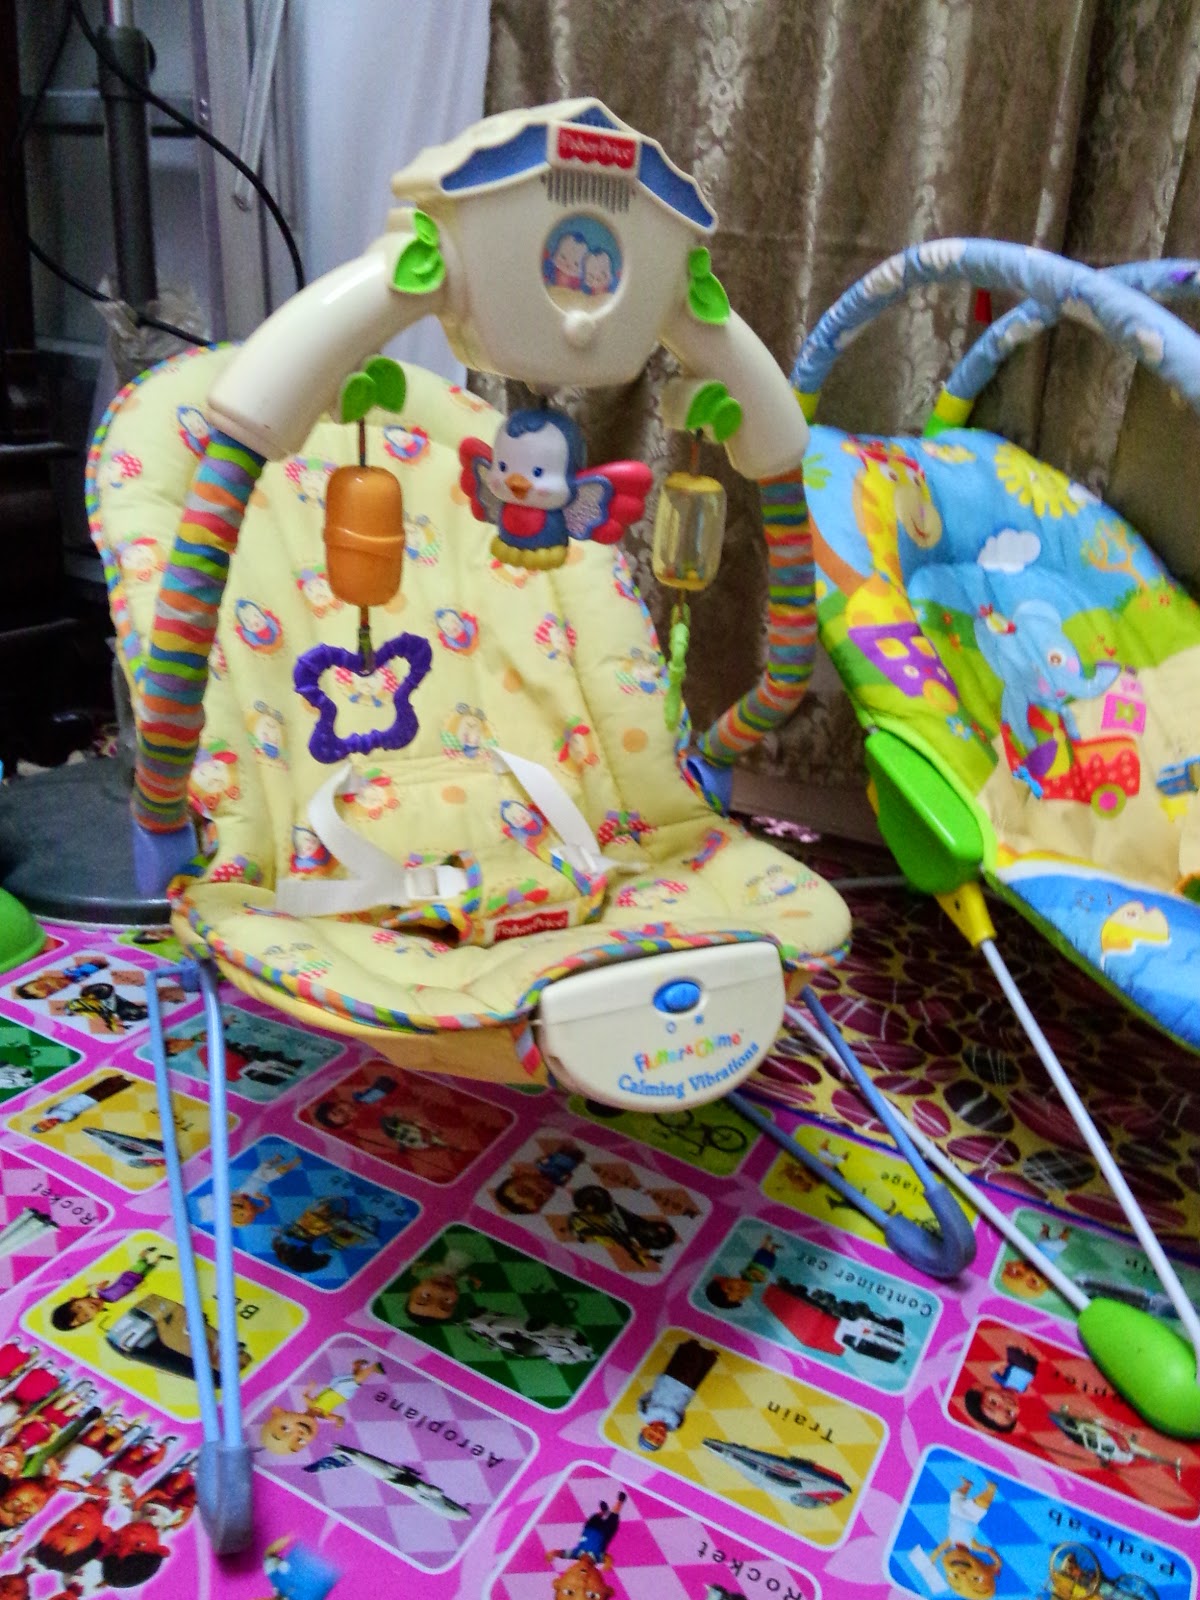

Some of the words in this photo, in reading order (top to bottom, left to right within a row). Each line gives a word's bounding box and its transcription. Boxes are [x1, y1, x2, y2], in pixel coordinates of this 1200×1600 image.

[618, 1074, 685, 1100] Calming
[688, 1041, 759, 1091] Vibrations
[31, 1184, 97, 1226] Rocket
[797, 1252, 828, 1273] car
[833, 1268, 933, 1319] Container
[373, 1391, 506, 1470] Aeroplane
[767, 1400, 833, 1444] Train
[1047, 1508, 1175, 1578] Pedicab
